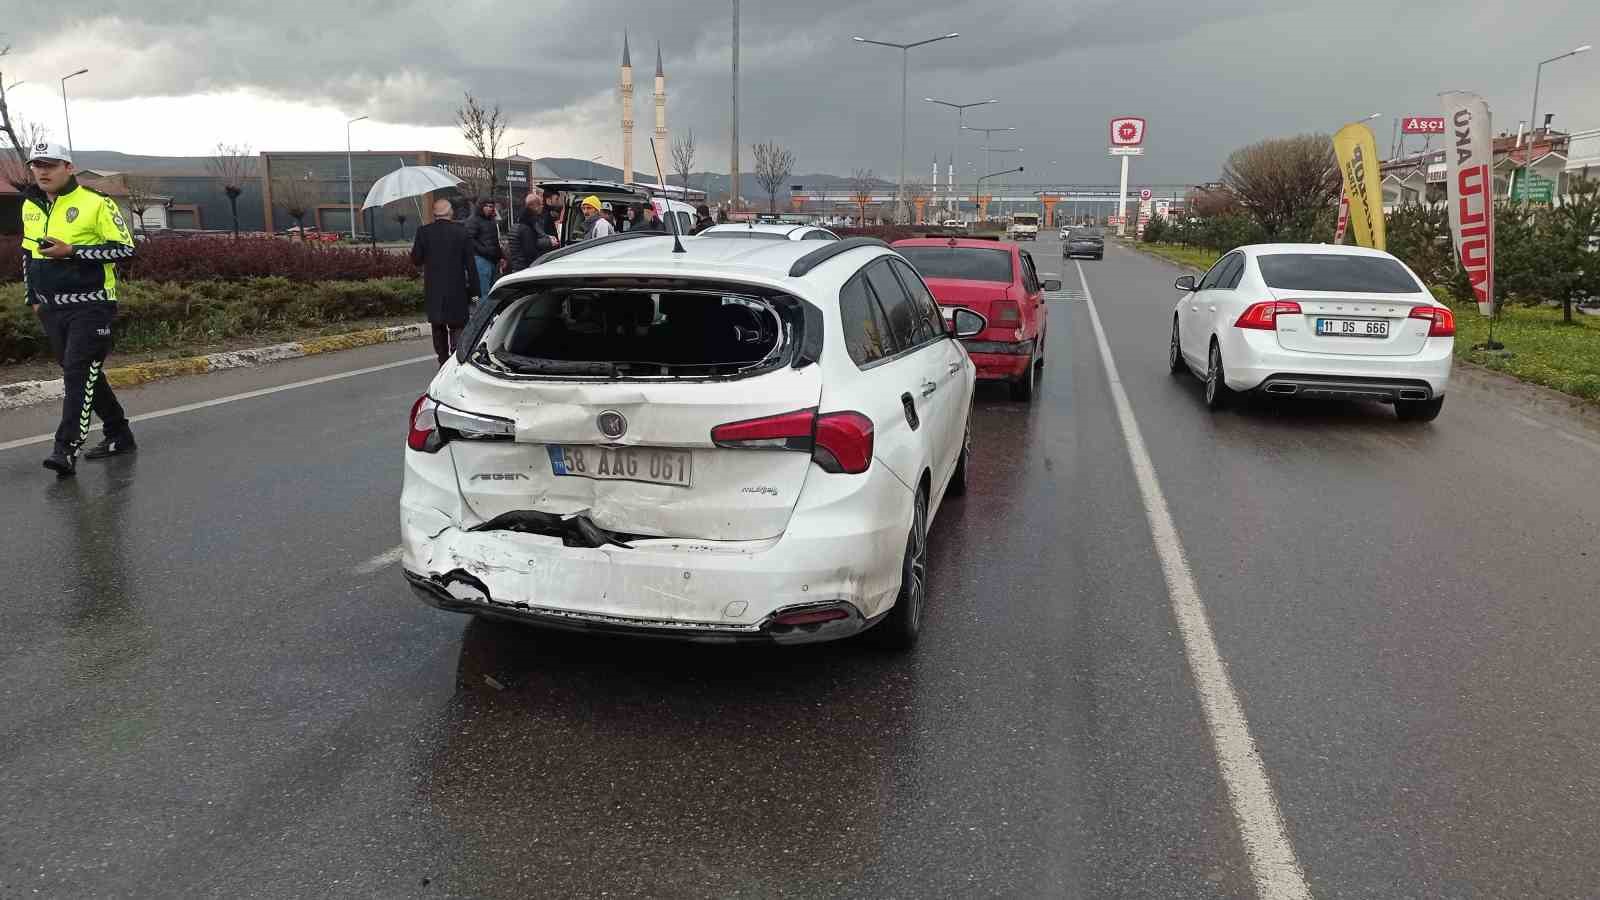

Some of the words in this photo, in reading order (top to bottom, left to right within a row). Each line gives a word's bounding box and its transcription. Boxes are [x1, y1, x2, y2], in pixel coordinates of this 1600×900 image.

[1325, 320, 1333, 332] 11
[1342, 321, 1356, 333] DS
[1366, 322, 1386, 334] 666
[565, 447, 586, 473] 58
[597, 450, 638, 477] AAG
[649, 452, 685, 482] 061
